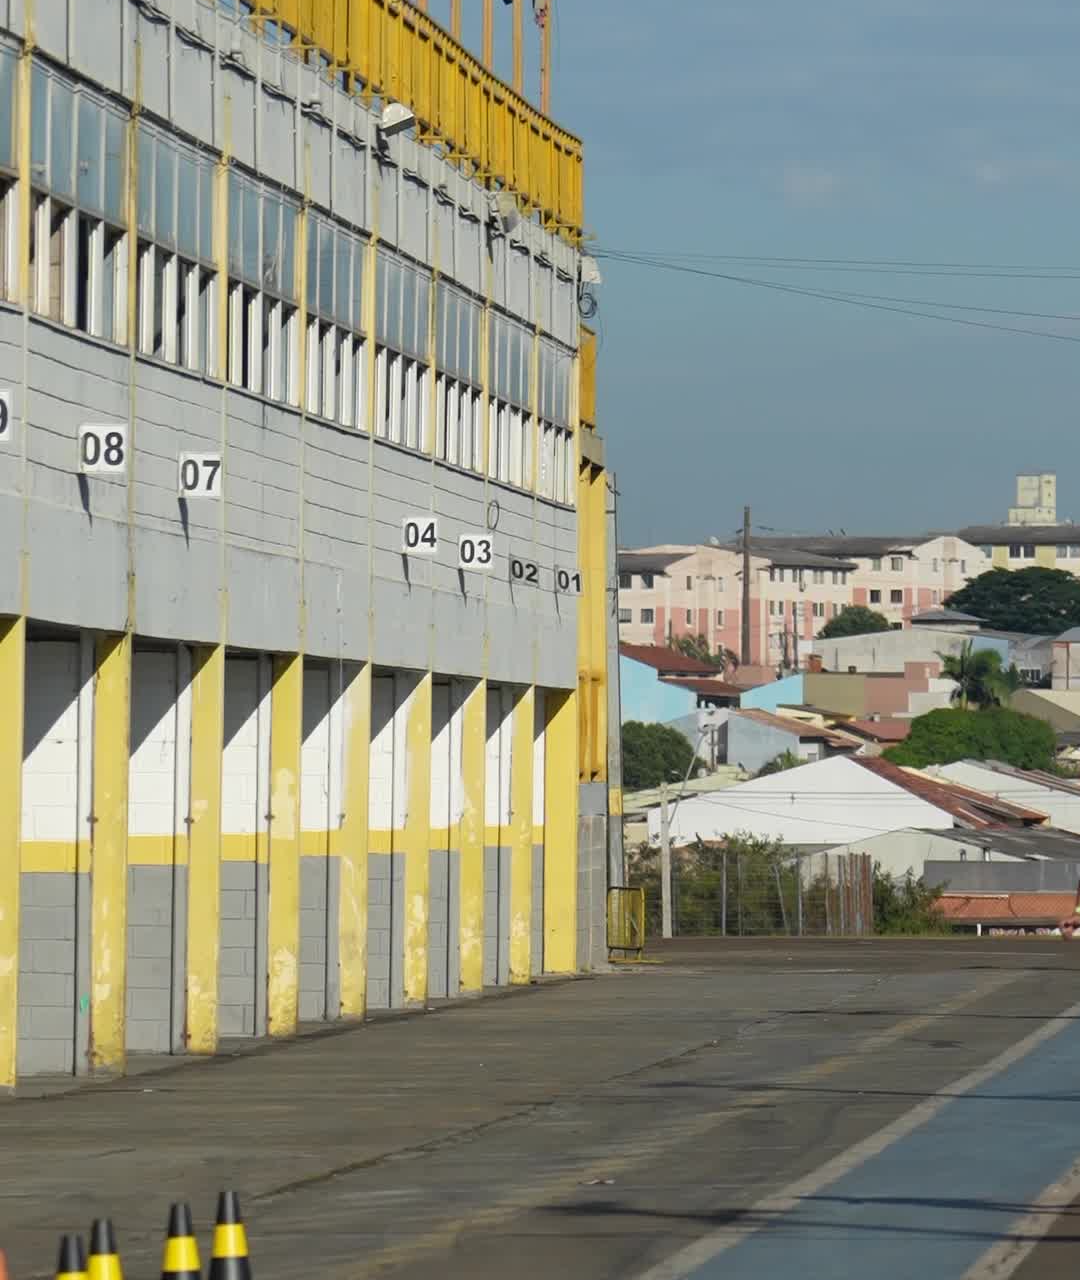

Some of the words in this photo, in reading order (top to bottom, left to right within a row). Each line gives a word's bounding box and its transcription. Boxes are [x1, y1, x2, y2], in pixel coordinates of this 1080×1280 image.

[81, 431, 124, 466] 08
[180, 459, 221, 491] 07
[404, 522, 437, 548] 04
[459, 539, 492, 564] 03
[511, 560, 539, 583] 02
[557, 570, 582, 593] 01
